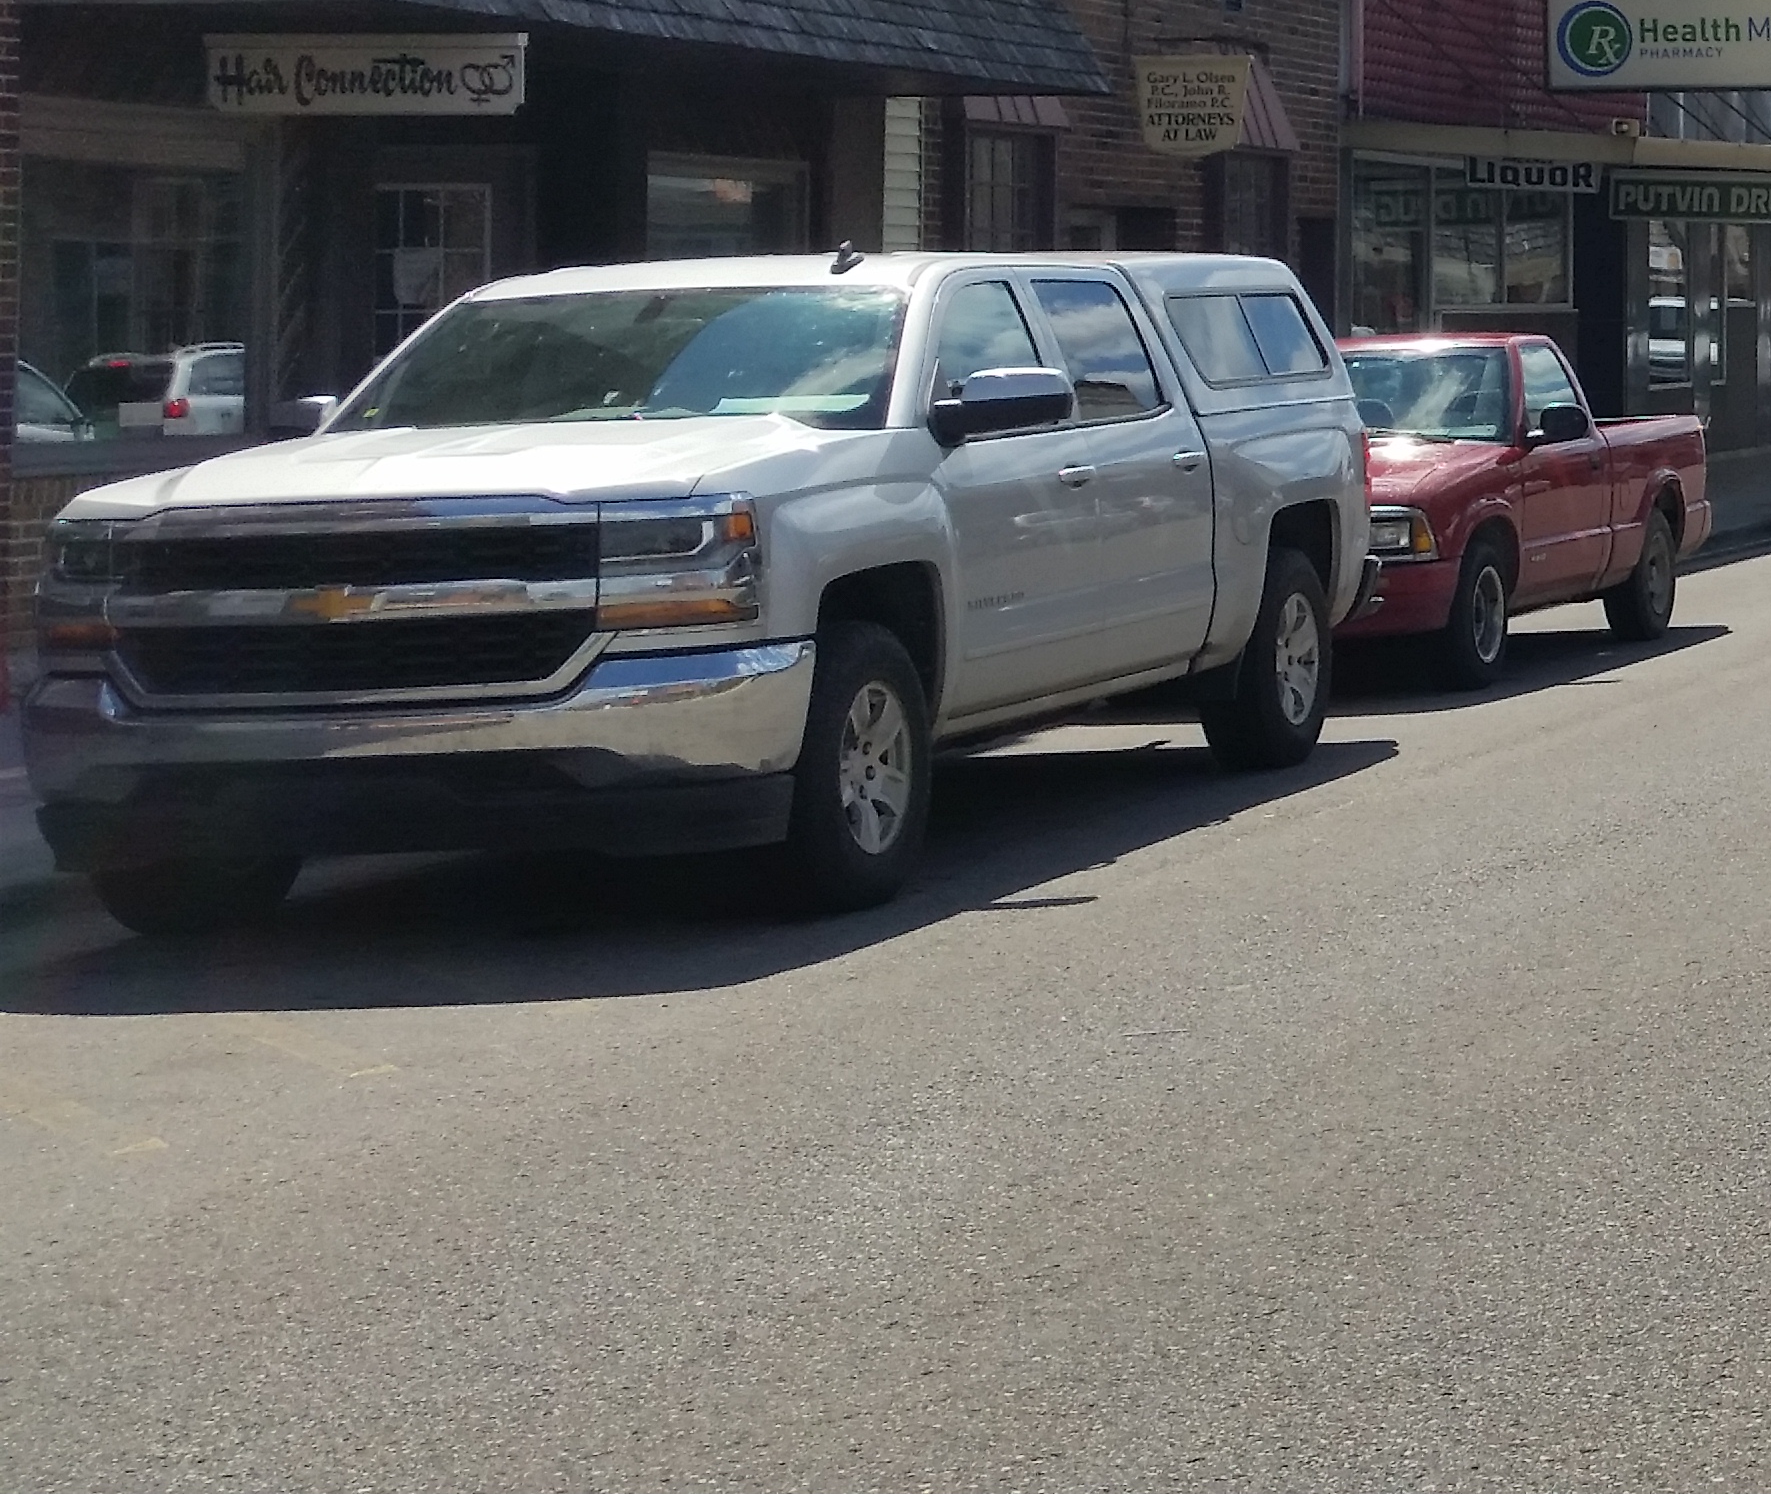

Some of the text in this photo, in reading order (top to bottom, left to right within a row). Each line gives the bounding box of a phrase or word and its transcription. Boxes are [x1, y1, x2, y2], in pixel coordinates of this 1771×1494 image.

[1640, 17, 1740, 43] Health
[1640, 46, 1723, 58] PHARMACY
[214, 53, 458, 106] Hair Connection
[1147, 71, 1236, 84] Gary L. Olsen
[1183, 85, 1213, 97] John
[1218, 85, 1231, 95] R.
[1146, 113, 1235, 126] ATTORNEYS
[1162, 127, 1218, 142] AT LAW
[1469, 155, 1594, 189] LIQUOR
[1618, 184, 1720, 213] PUTVIN
